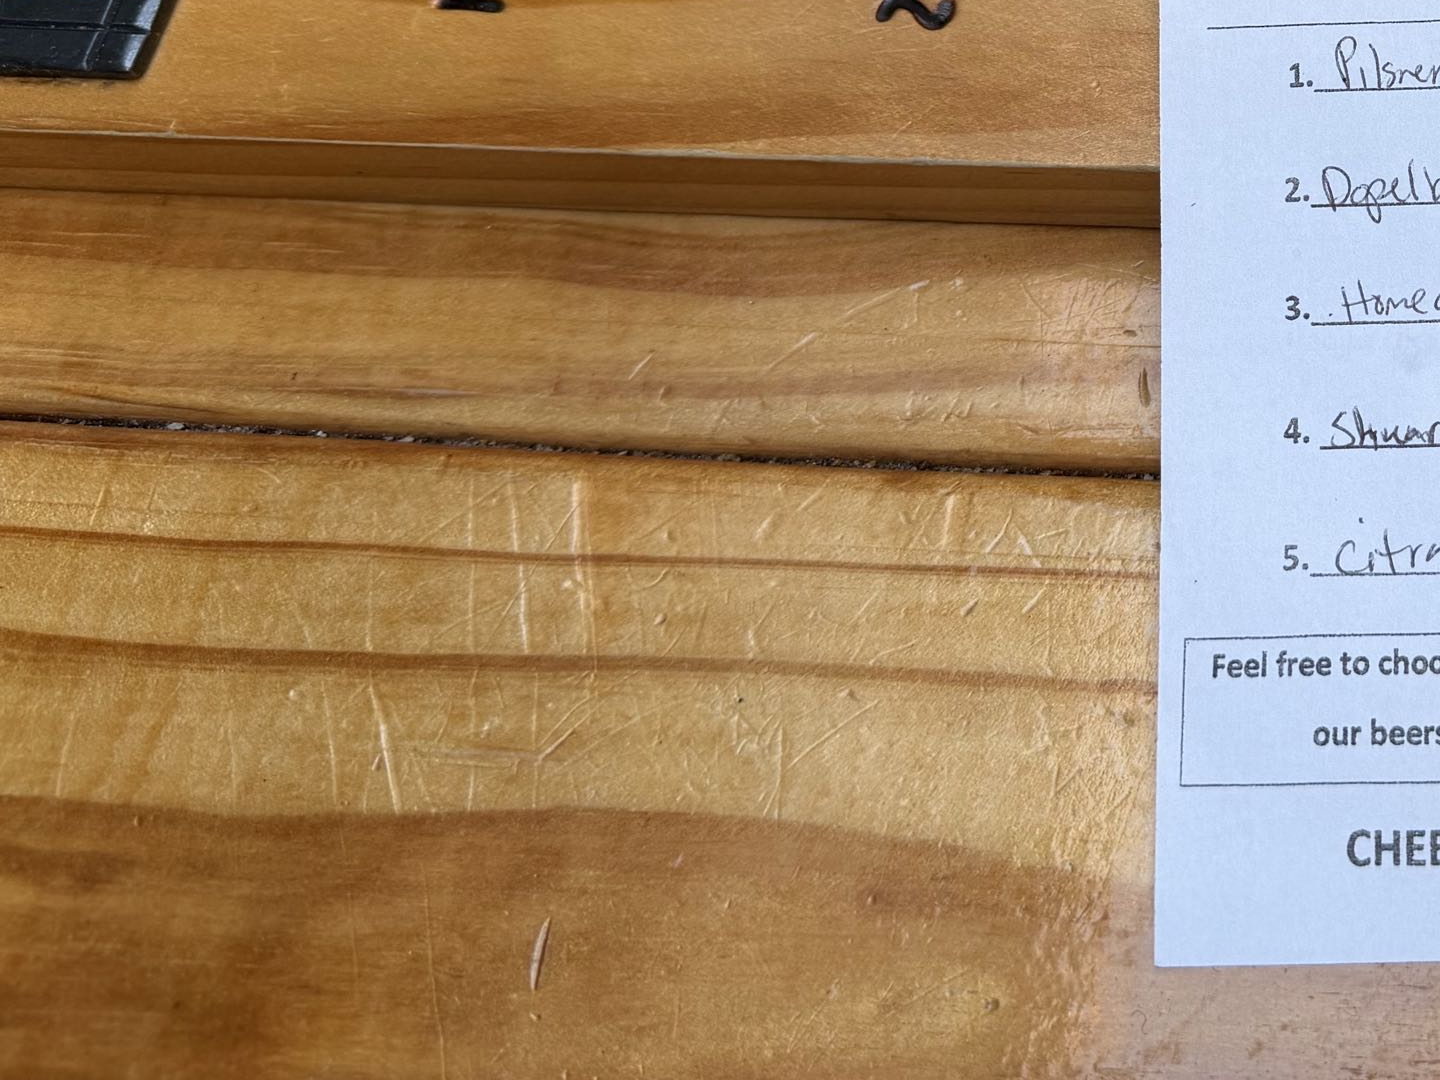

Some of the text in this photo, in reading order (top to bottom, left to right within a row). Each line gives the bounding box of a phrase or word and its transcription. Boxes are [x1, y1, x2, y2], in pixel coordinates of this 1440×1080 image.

[1289, 62, 1314, 89] 1.
[1285, 177, 1310, 203] 2.
[1285, 295, 1310, 320] 3.
[1283, 417, 1310, 445] 4.
[1282, 544, 1309, 571] 5.
[1212, 650, 1268, 679] Feel
[1276, 649, 1332, 677] free
[1340, 650, 1370, 676] to
[1313, 723, 1362, 746] our
